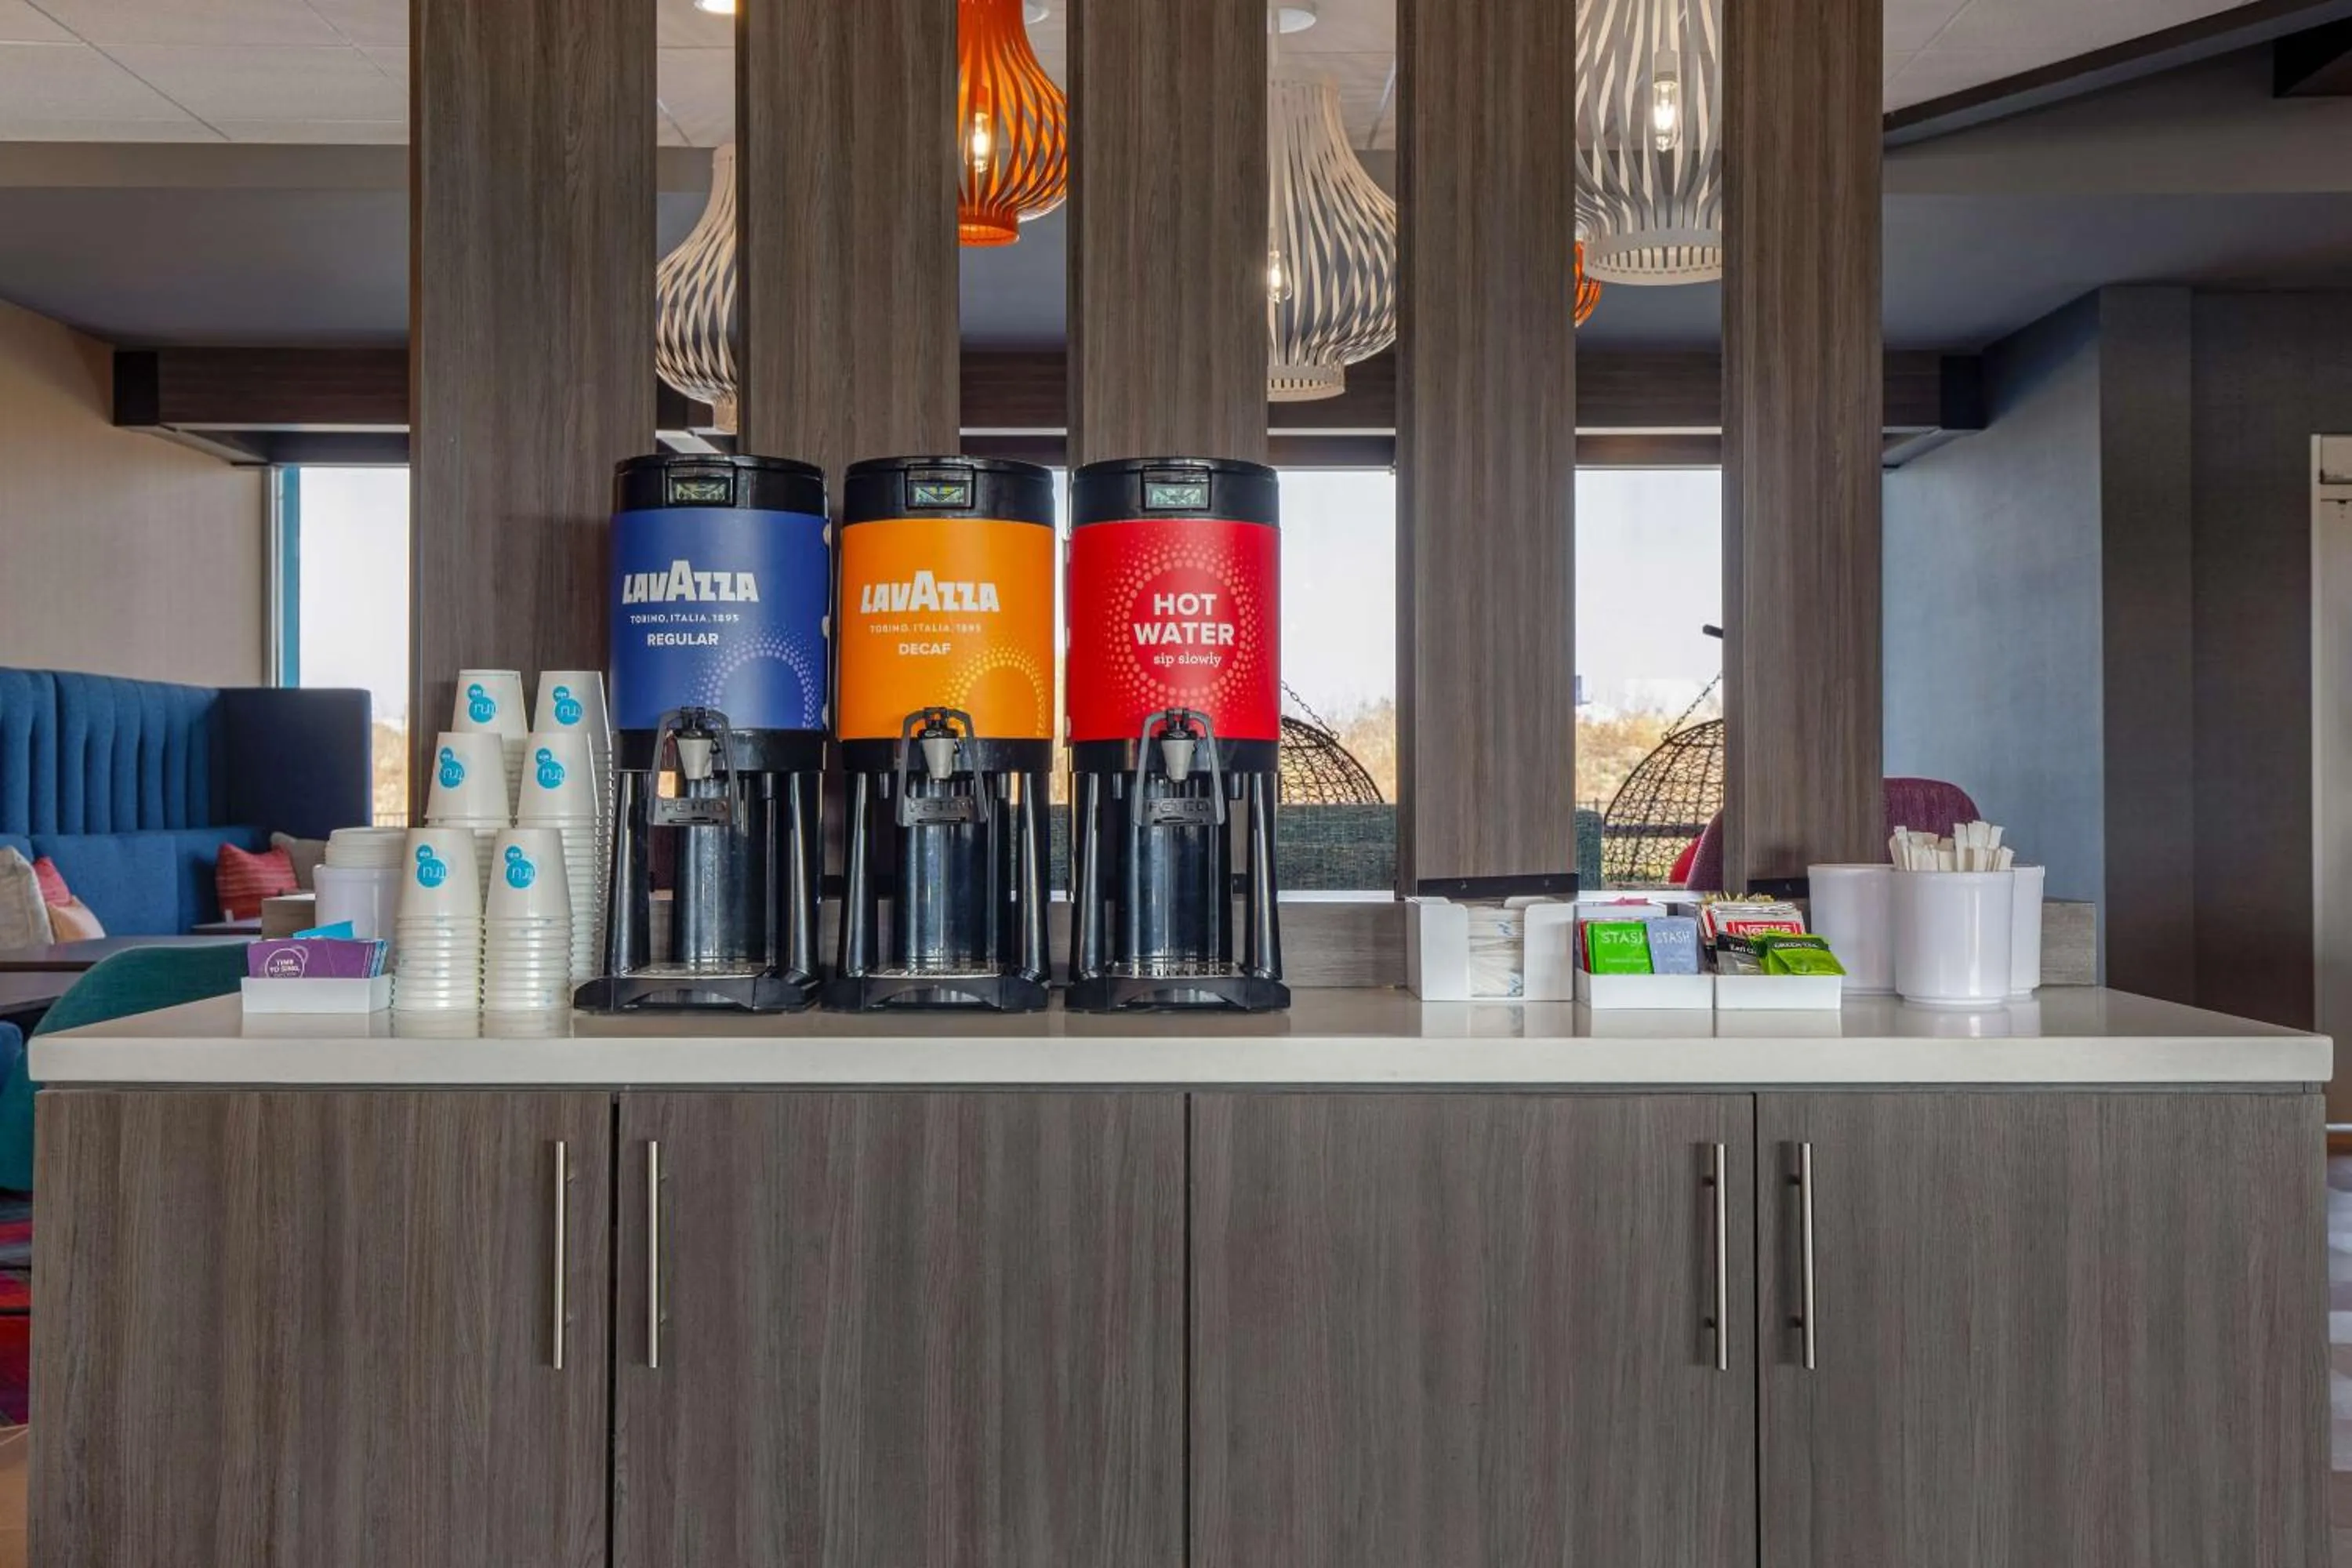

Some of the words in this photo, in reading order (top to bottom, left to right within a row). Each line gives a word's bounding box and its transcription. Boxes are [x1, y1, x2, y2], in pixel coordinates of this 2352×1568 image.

[622, 560, 759, 604] LAVAZZA
[860, 570, 1000, 613] LAVAZZA
[1154, 593, 1217, 615] HOT
[713, 613, 740, 622] 1895
[647, 633, 719, 646] REGULAR
[1133, 623, 1235, 644] WATER
[898, 642, 952, 655] DECAF
[1153, 652, 1174, 666] sip
[1178, 650, 1222, 666] slowly
[423, 866, 445, 879] tru
[1654, 930, 1690, 944] STASH
